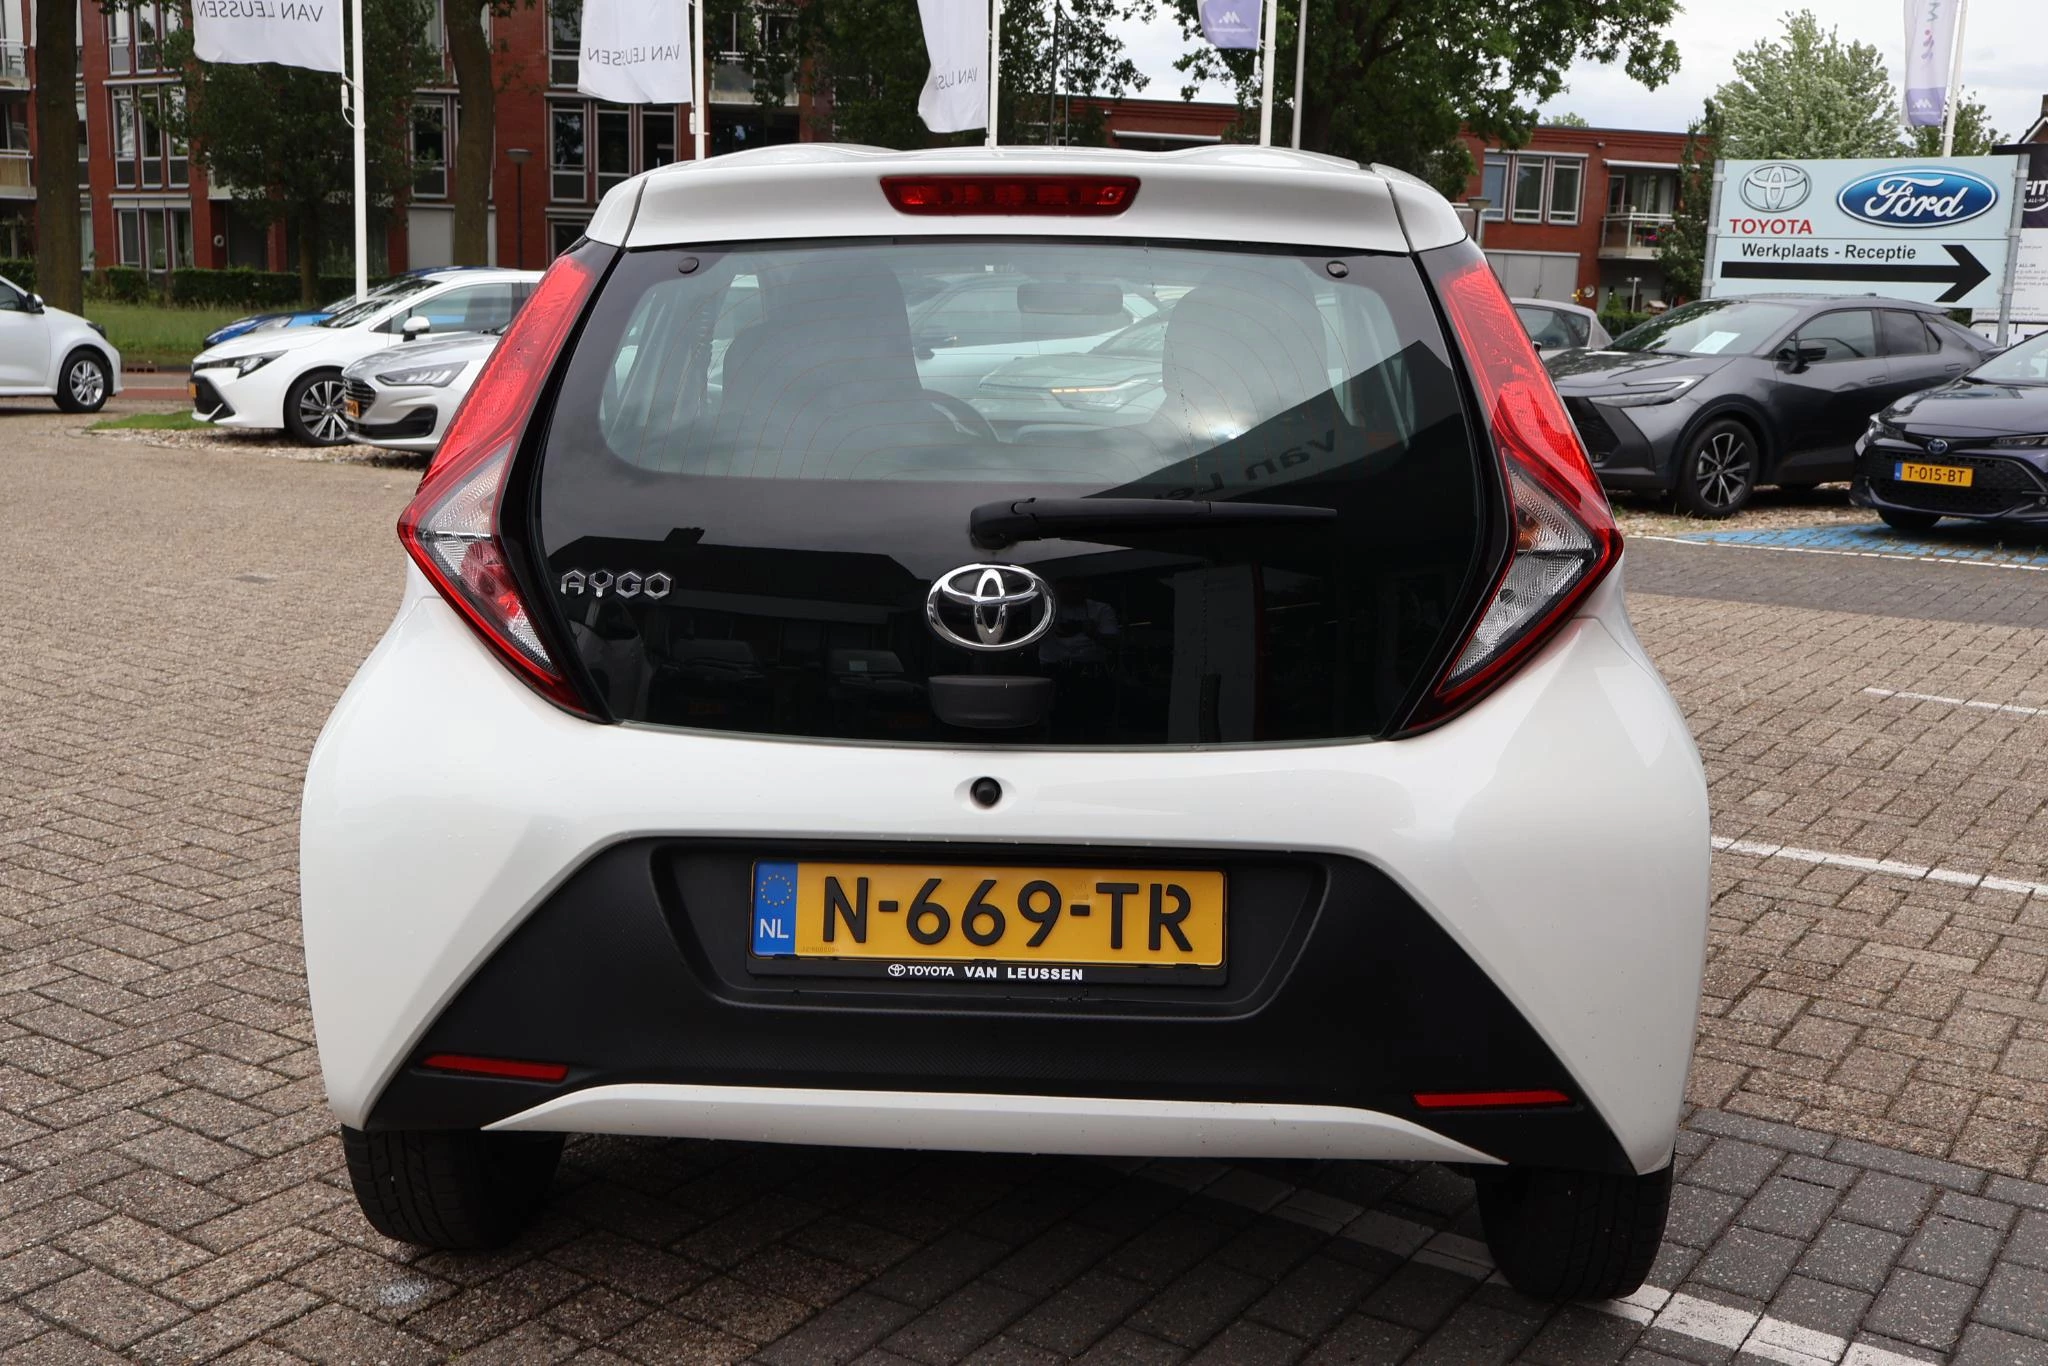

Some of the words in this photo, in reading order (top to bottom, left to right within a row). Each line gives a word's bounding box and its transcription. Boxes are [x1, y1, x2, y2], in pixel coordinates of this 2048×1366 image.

[1864, 177, 1969, 218] Ford
[1729, 218, 1813, 235] TOYOTA
[1741, 243, 1829, 260] Werkplaats
[1845, 244, 1917, 260] Receptie
[1907, 465, 1966, 484] T-015-BT
[560, 568, 672, 600] AYGO
[822, 876, 1194, 952] N-669-TR
[759, 918, 790, 940] NL
[907, 964, 955, 978] TOYOTA
[964, 966, 998, 980] VAN
[1006, 967, 1084, 981] LEUSSEN
